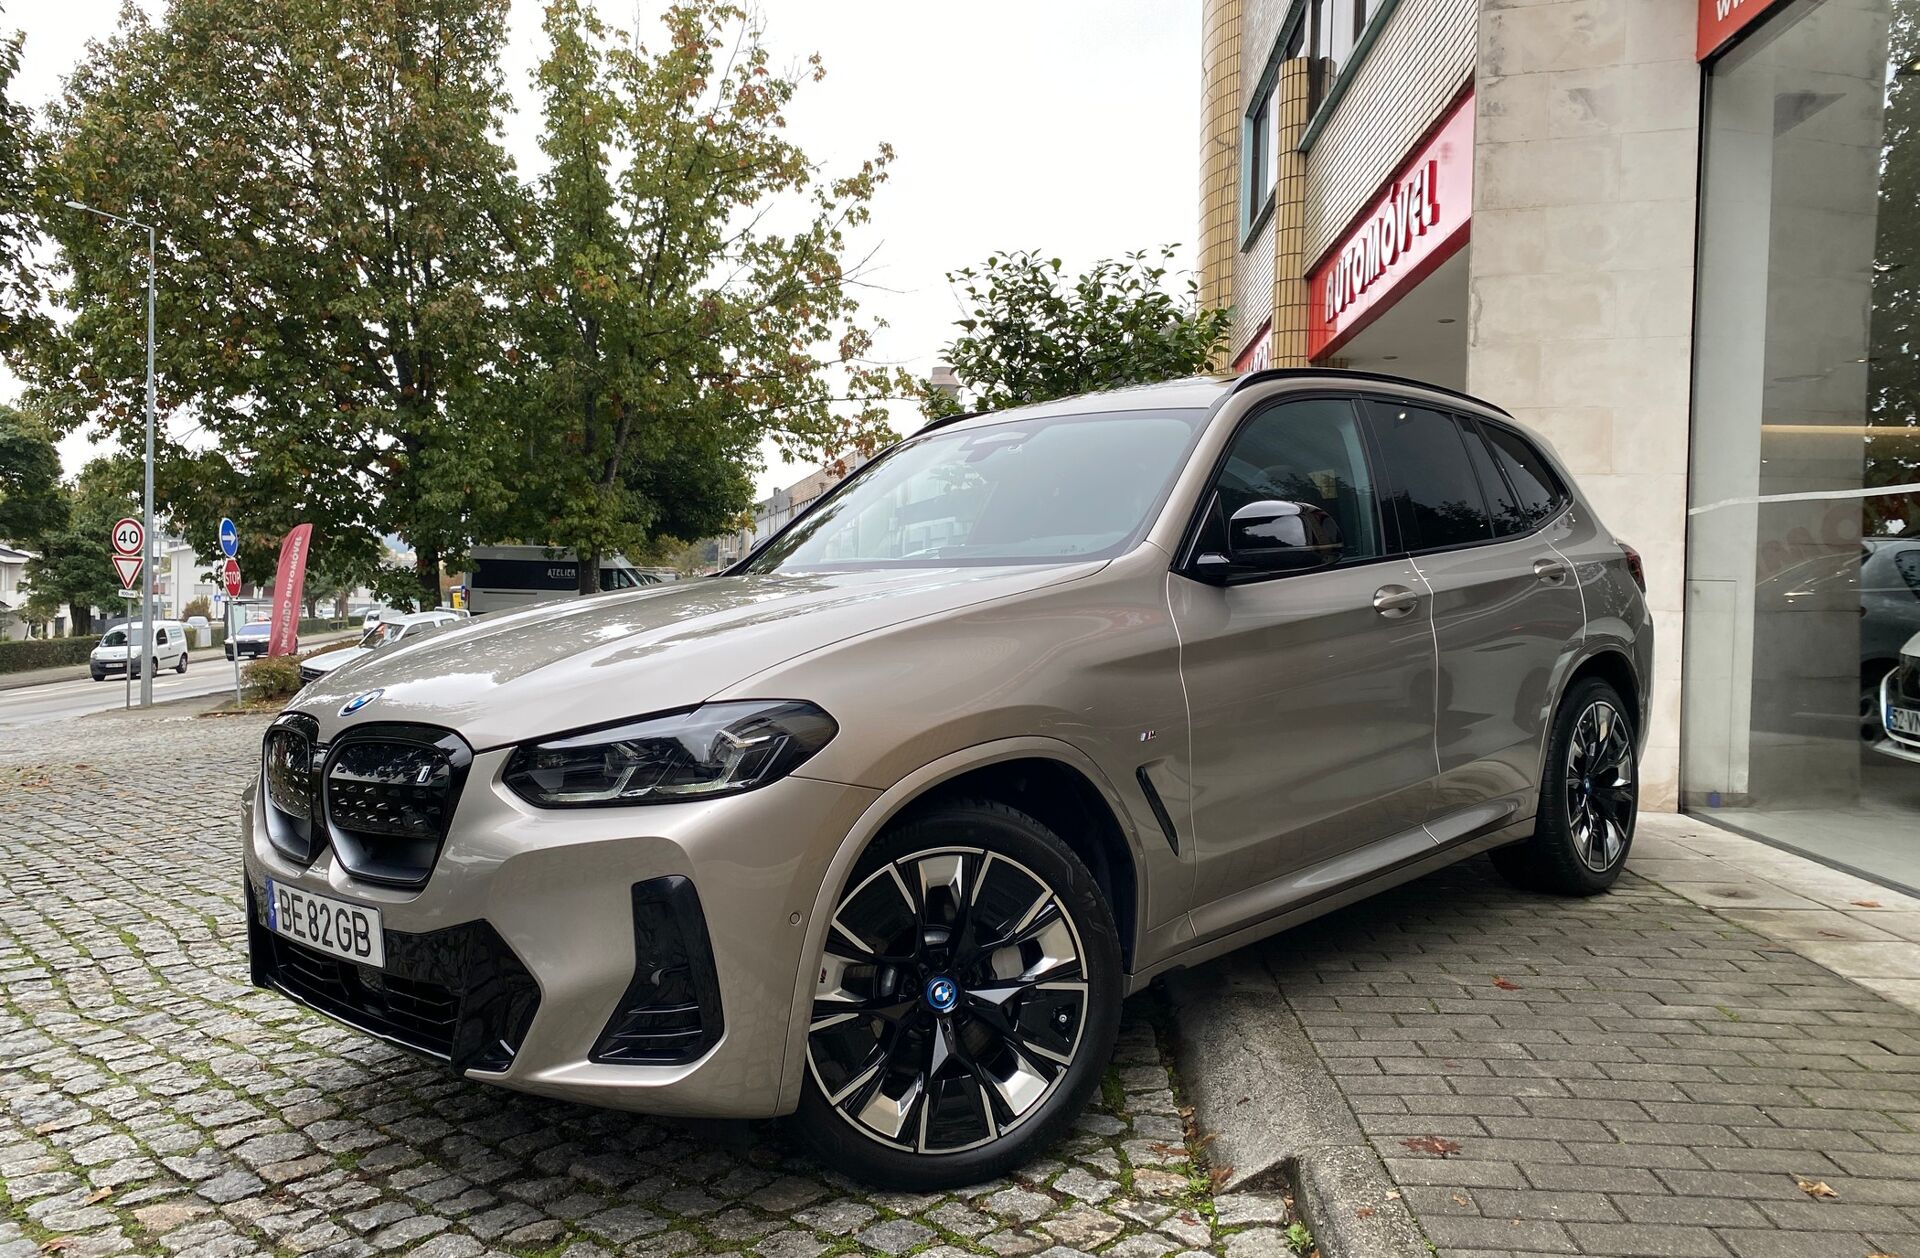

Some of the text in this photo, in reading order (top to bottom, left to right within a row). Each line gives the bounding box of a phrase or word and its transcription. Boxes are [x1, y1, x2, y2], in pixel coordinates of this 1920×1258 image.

[1325, 160, 1440, 323] AUTOMÓVEL
[118, 530, 138, 544] 40
[225, 571, 241, 585] STOP
[279, 888, 371, 958] BE82GB
